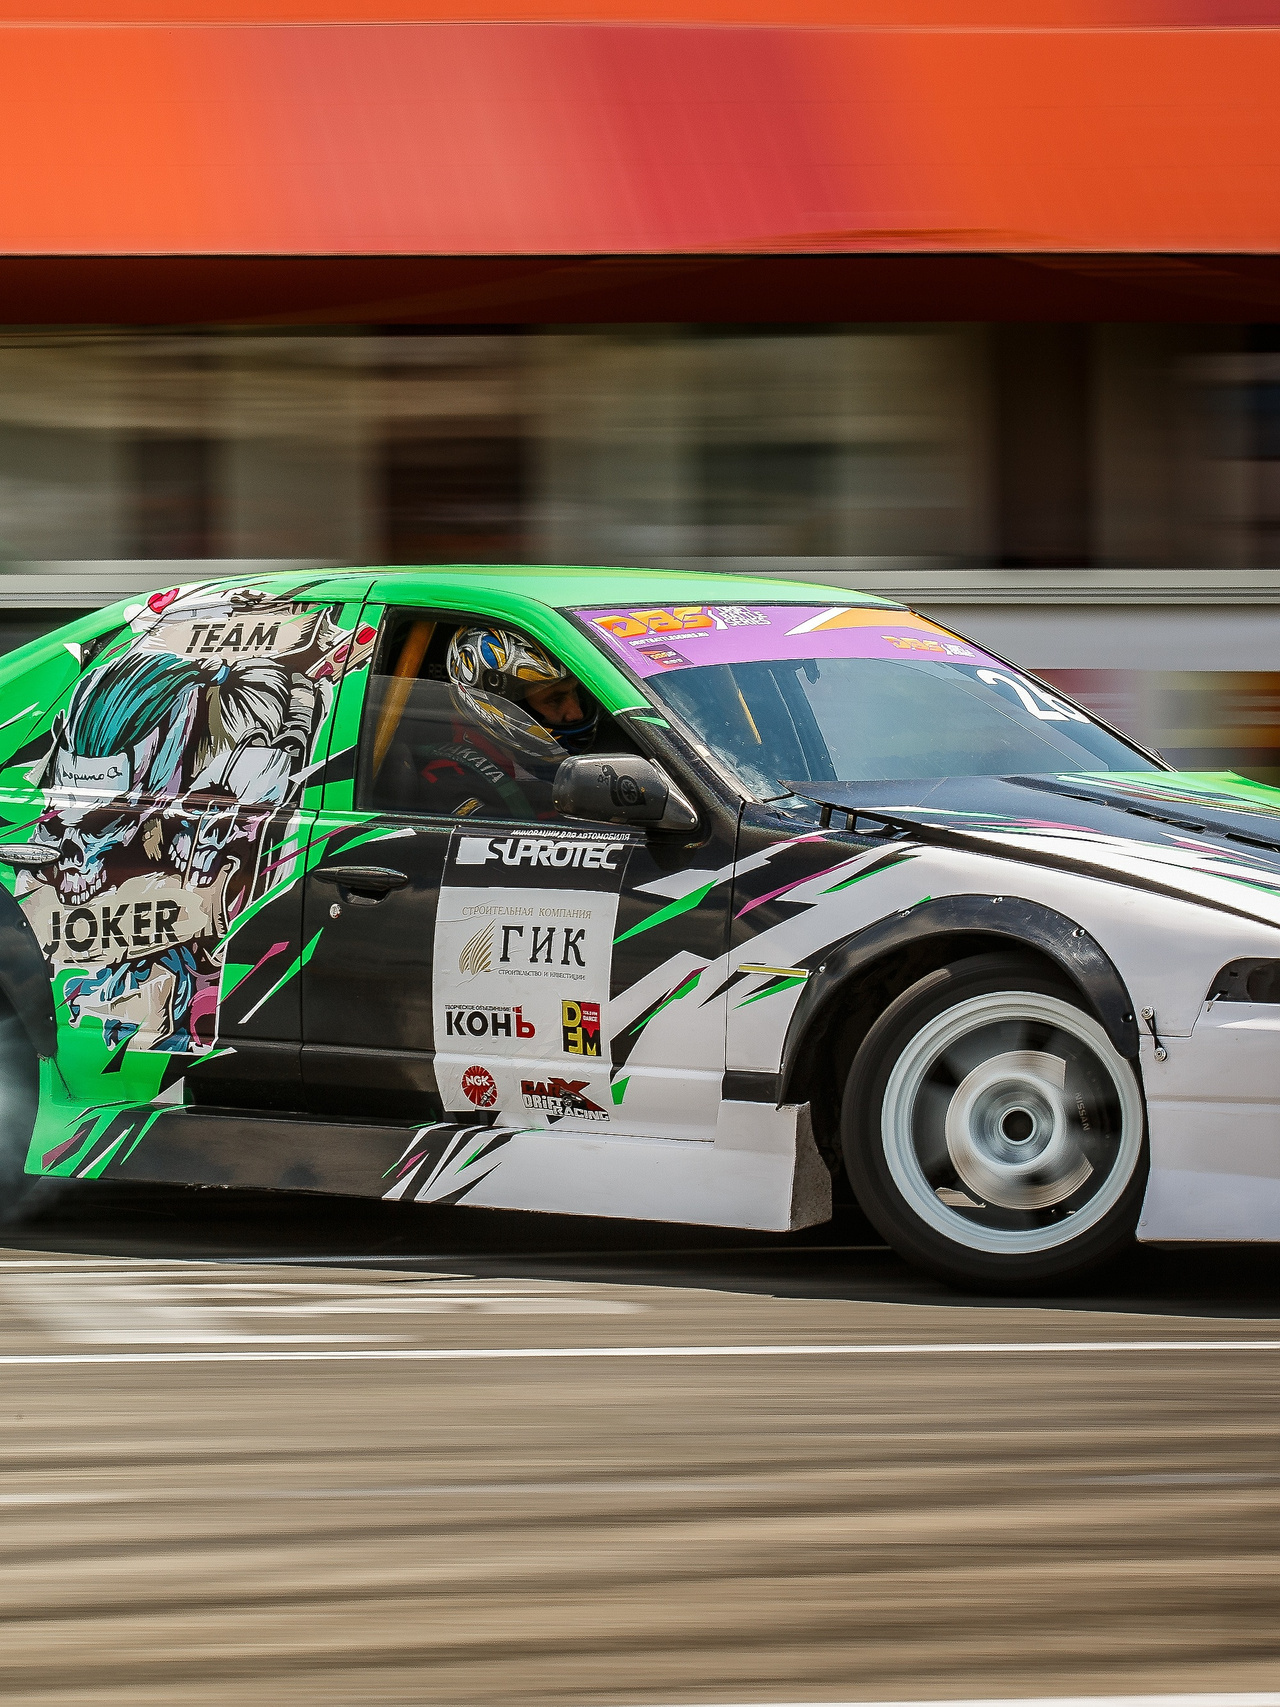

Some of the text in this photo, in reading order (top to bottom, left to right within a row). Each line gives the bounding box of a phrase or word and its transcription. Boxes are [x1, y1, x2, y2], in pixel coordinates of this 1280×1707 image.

[185, 622, 282, 653] TEAM
[484, 837, 625, 870] SUPROTEC
[43, 900, 181, 955] JOKER
[462, 906, 592, 919] СТРОИТЕЛЬНАЯ КОМПАНИЯ
[500, 925, 586, 967] ГИК
[465, 1075, 490, 1087] NGK
[550, 1105, 610, 1121] RACING
[1075, 1092, 1091, 1131] NISSAN
